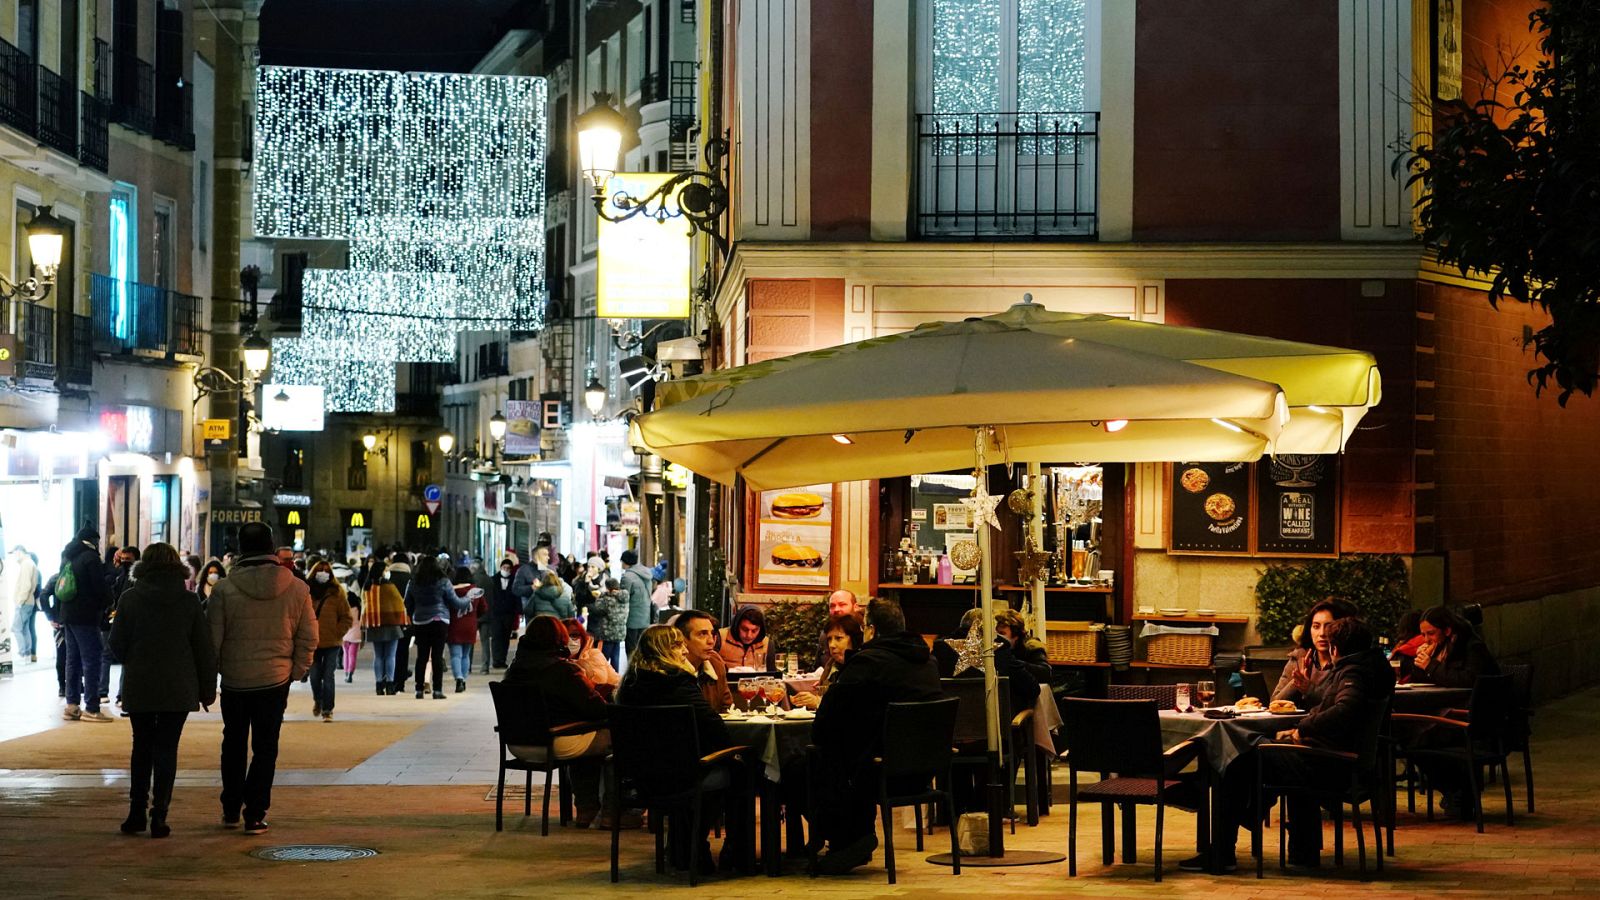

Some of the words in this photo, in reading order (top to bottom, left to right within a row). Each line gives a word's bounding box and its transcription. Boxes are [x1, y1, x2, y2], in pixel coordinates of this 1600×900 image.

[208, 424, 225, 432] ATM
[211, 510, 261, 523] FOREVER
[1283, 507, 1311, 520] WINE
[1287, 520, 1311, 528] CALLED
